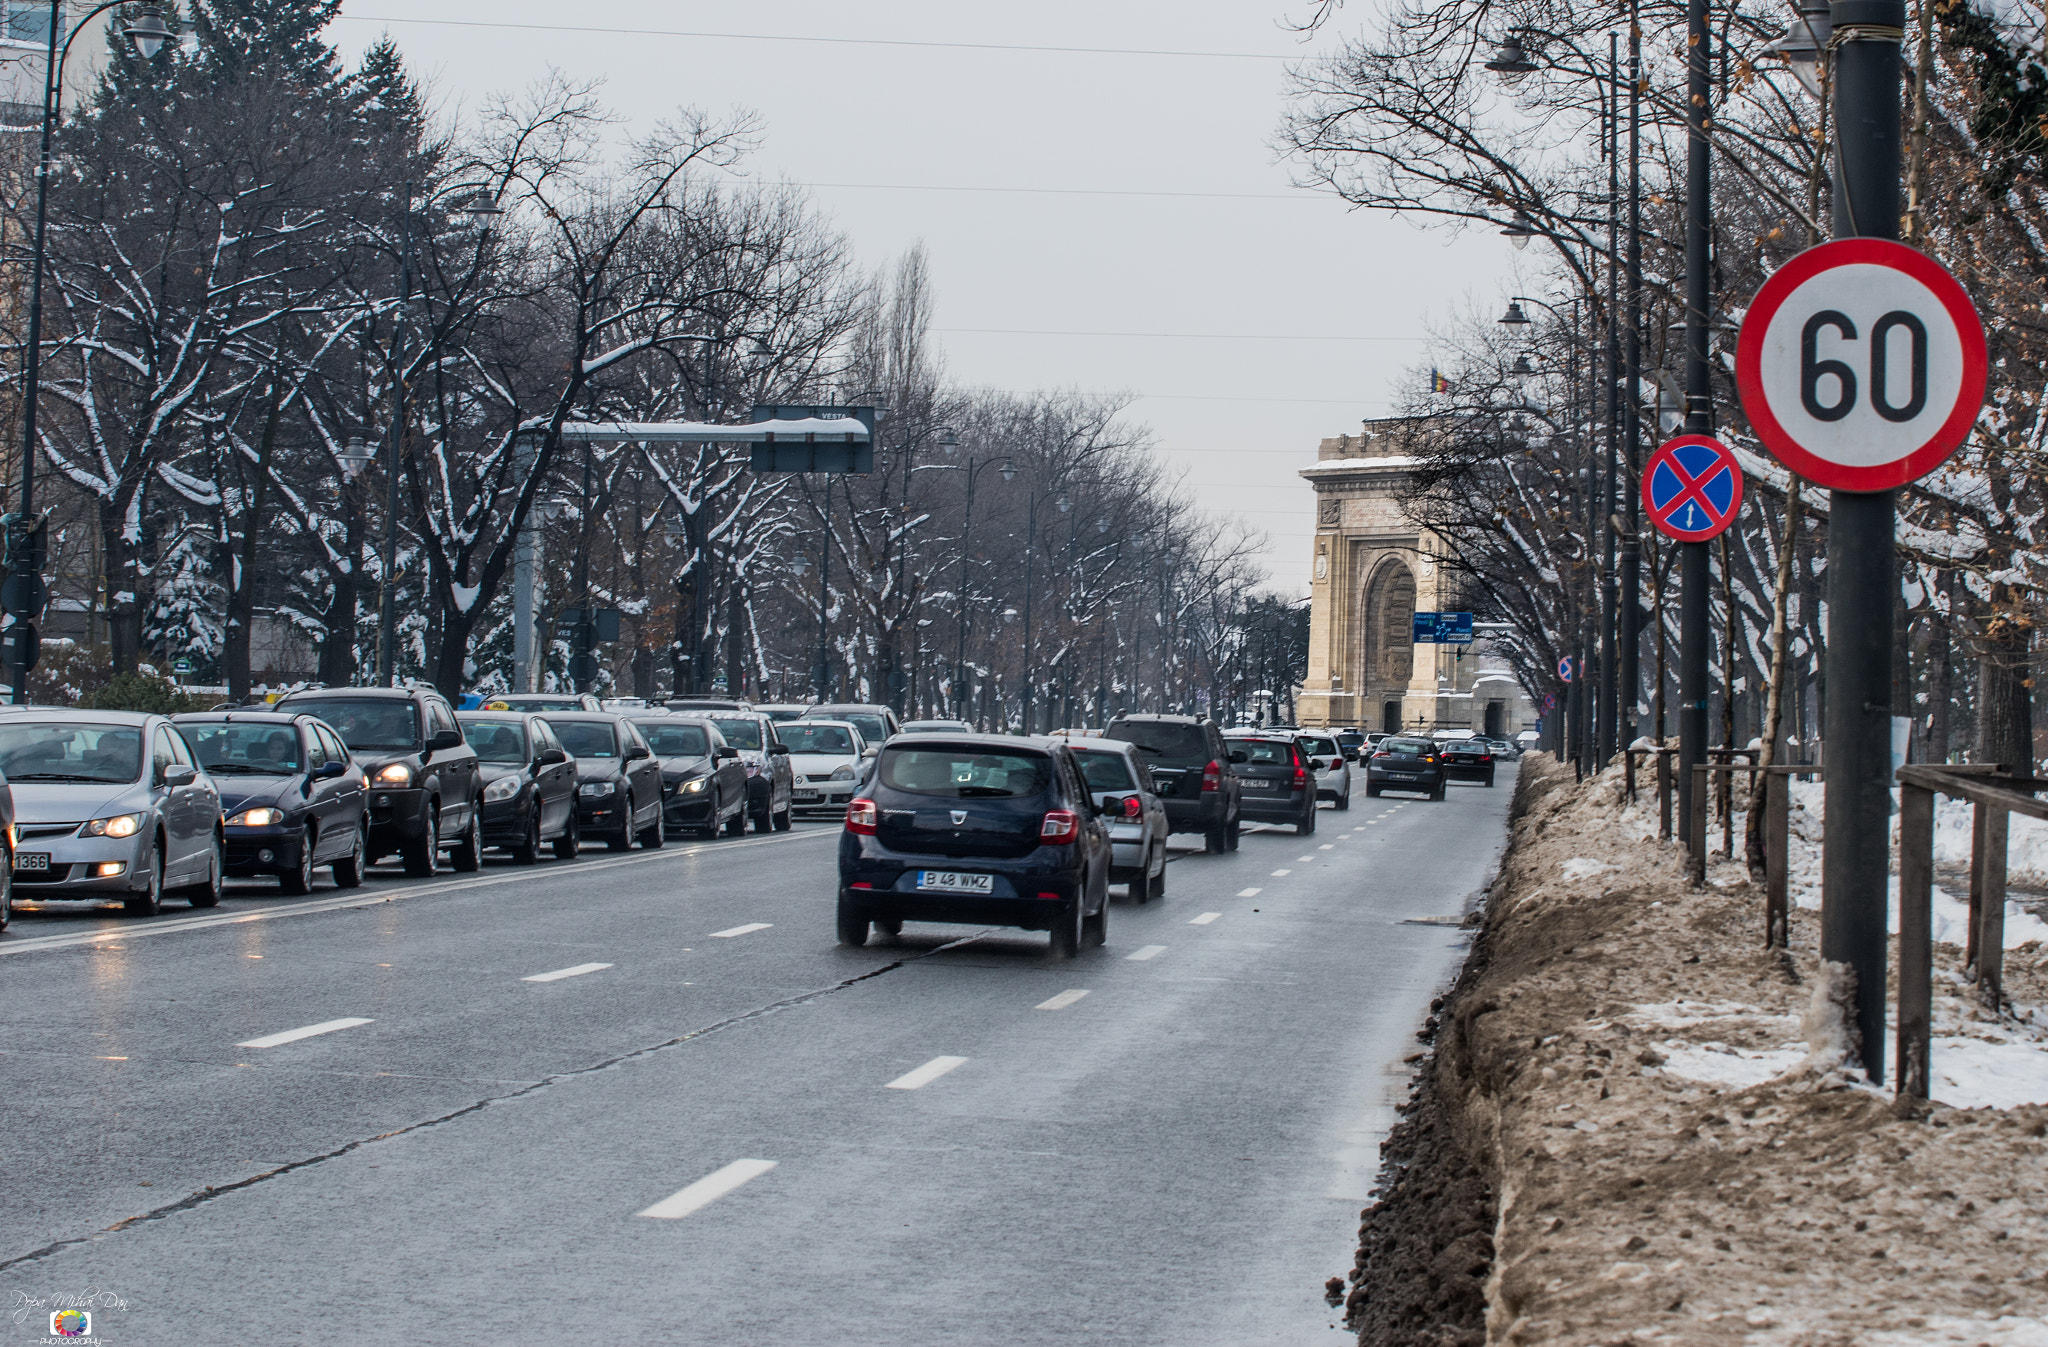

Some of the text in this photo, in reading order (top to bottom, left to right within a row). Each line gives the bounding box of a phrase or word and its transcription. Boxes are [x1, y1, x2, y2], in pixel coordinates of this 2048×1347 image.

[1800, 310, 1929, 423] 60
[926, 872, 989, 888] B 48 WMZ
